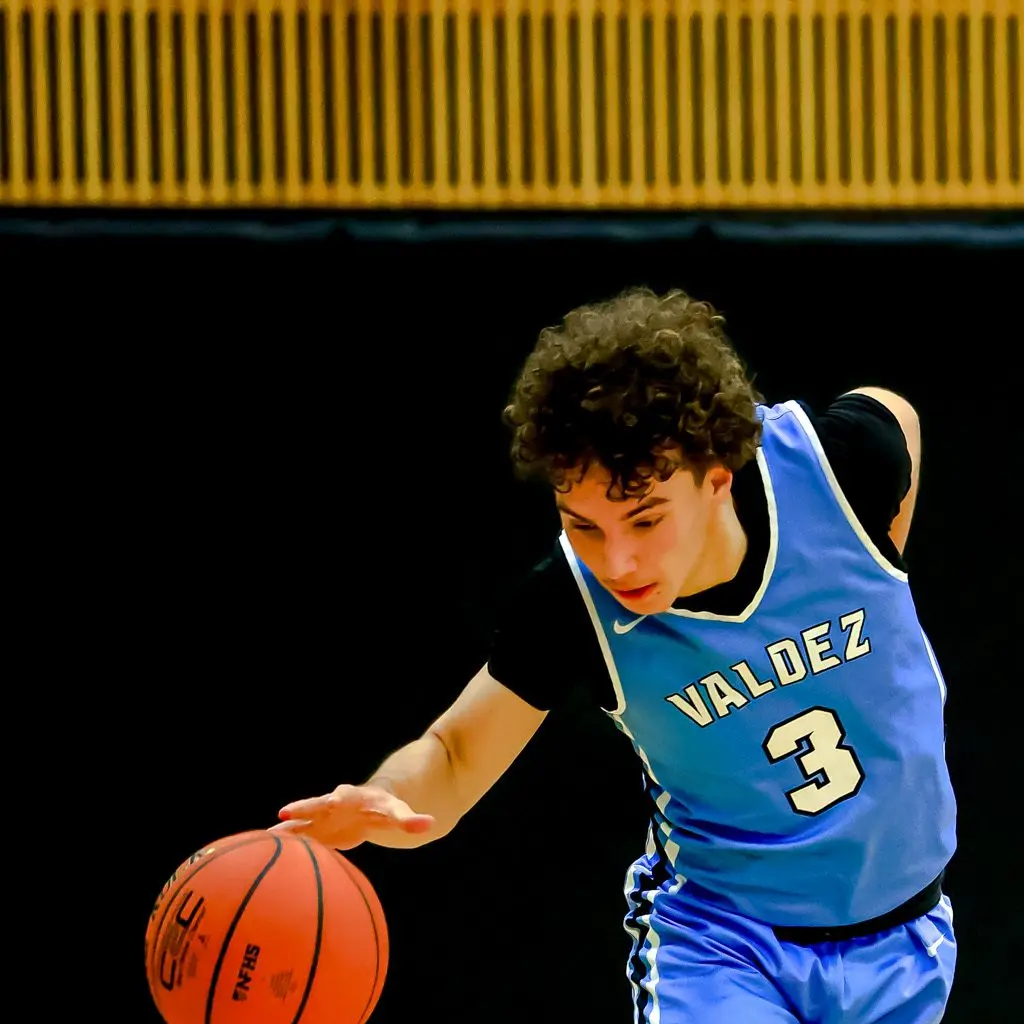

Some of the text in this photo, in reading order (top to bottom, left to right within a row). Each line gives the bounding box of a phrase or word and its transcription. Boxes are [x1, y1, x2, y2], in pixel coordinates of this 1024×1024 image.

[664, 607, 872, 728] VALDEZ
[762, 705, 866, 818] 3
[236, 943, 261, 991] NFHS
